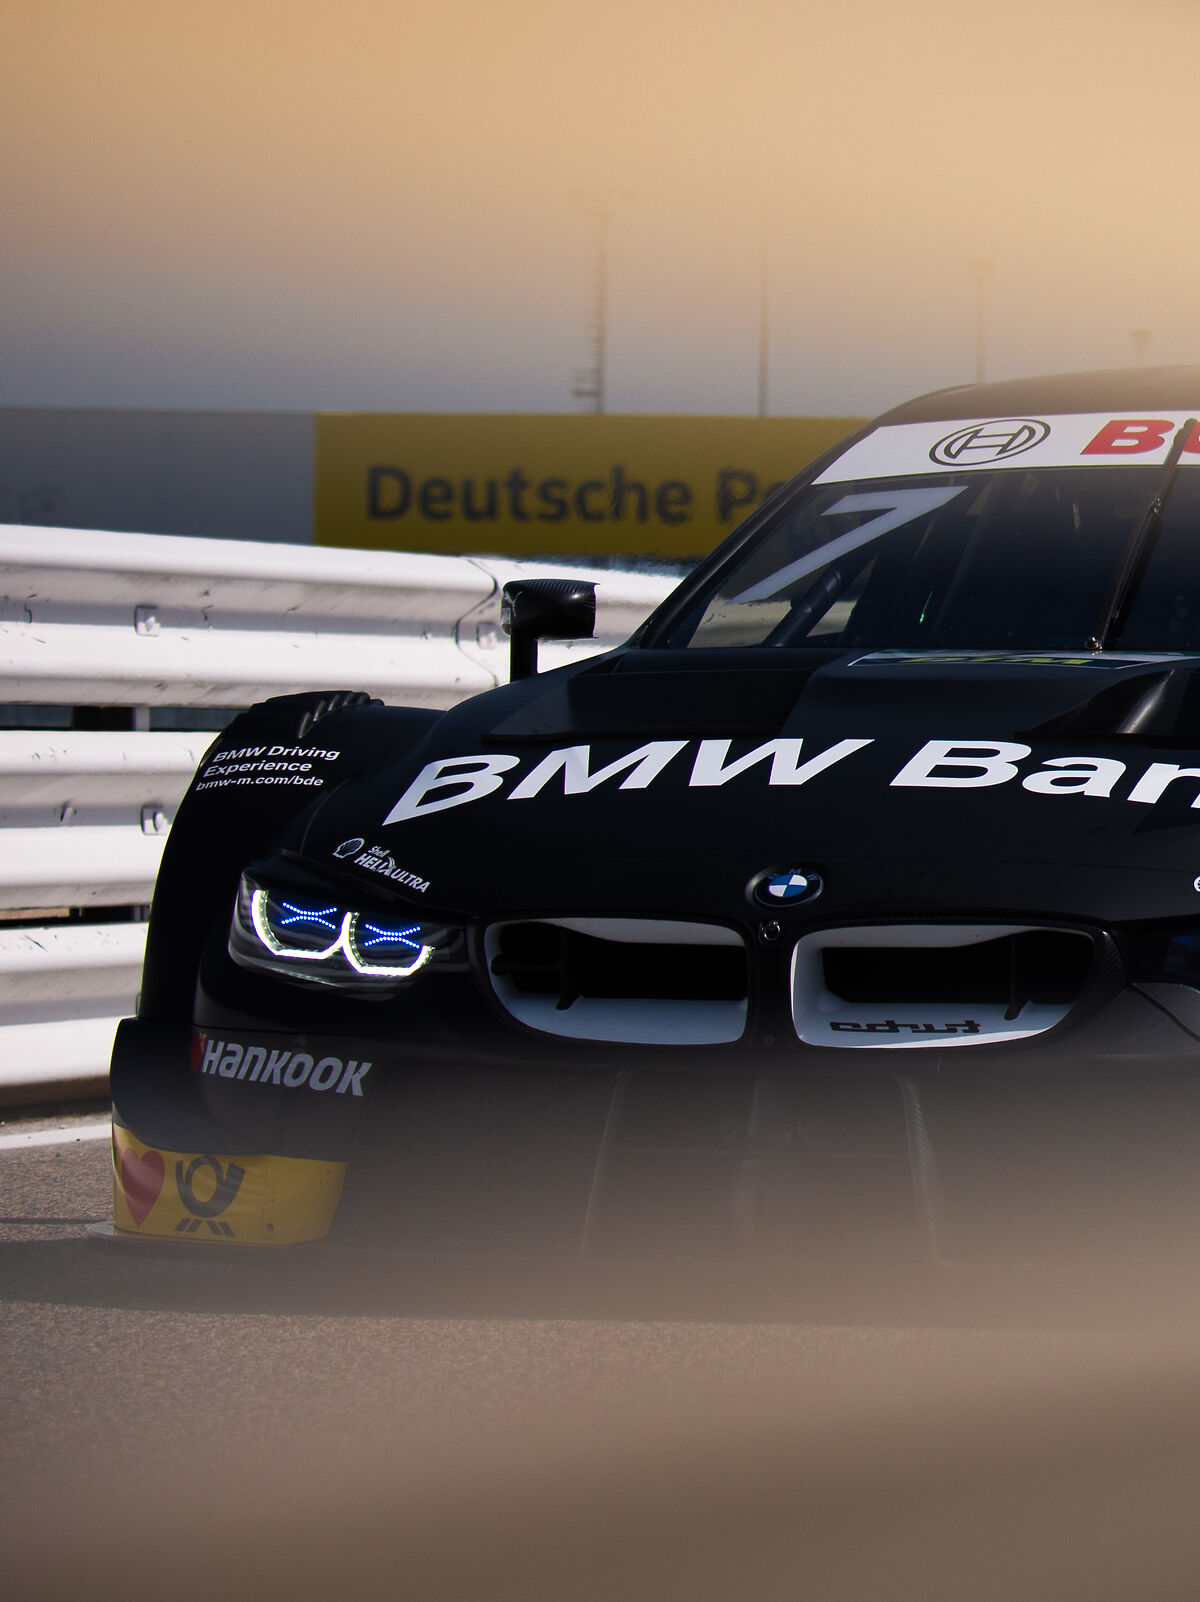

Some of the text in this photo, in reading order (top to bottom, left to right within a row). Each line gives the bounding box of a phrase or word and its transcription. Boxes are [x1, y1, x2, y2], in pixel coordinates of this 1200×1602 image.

[366, 465, 693, 526] Deutsche
[725, 485, 970, 605] 7
[203, 760, 313, 778] Experience
[212, 745, 341, 763] BMW Driving
[196, 775, 324, 791] bmw-m.com/bde
[382, 738, 875, 827] BMW
